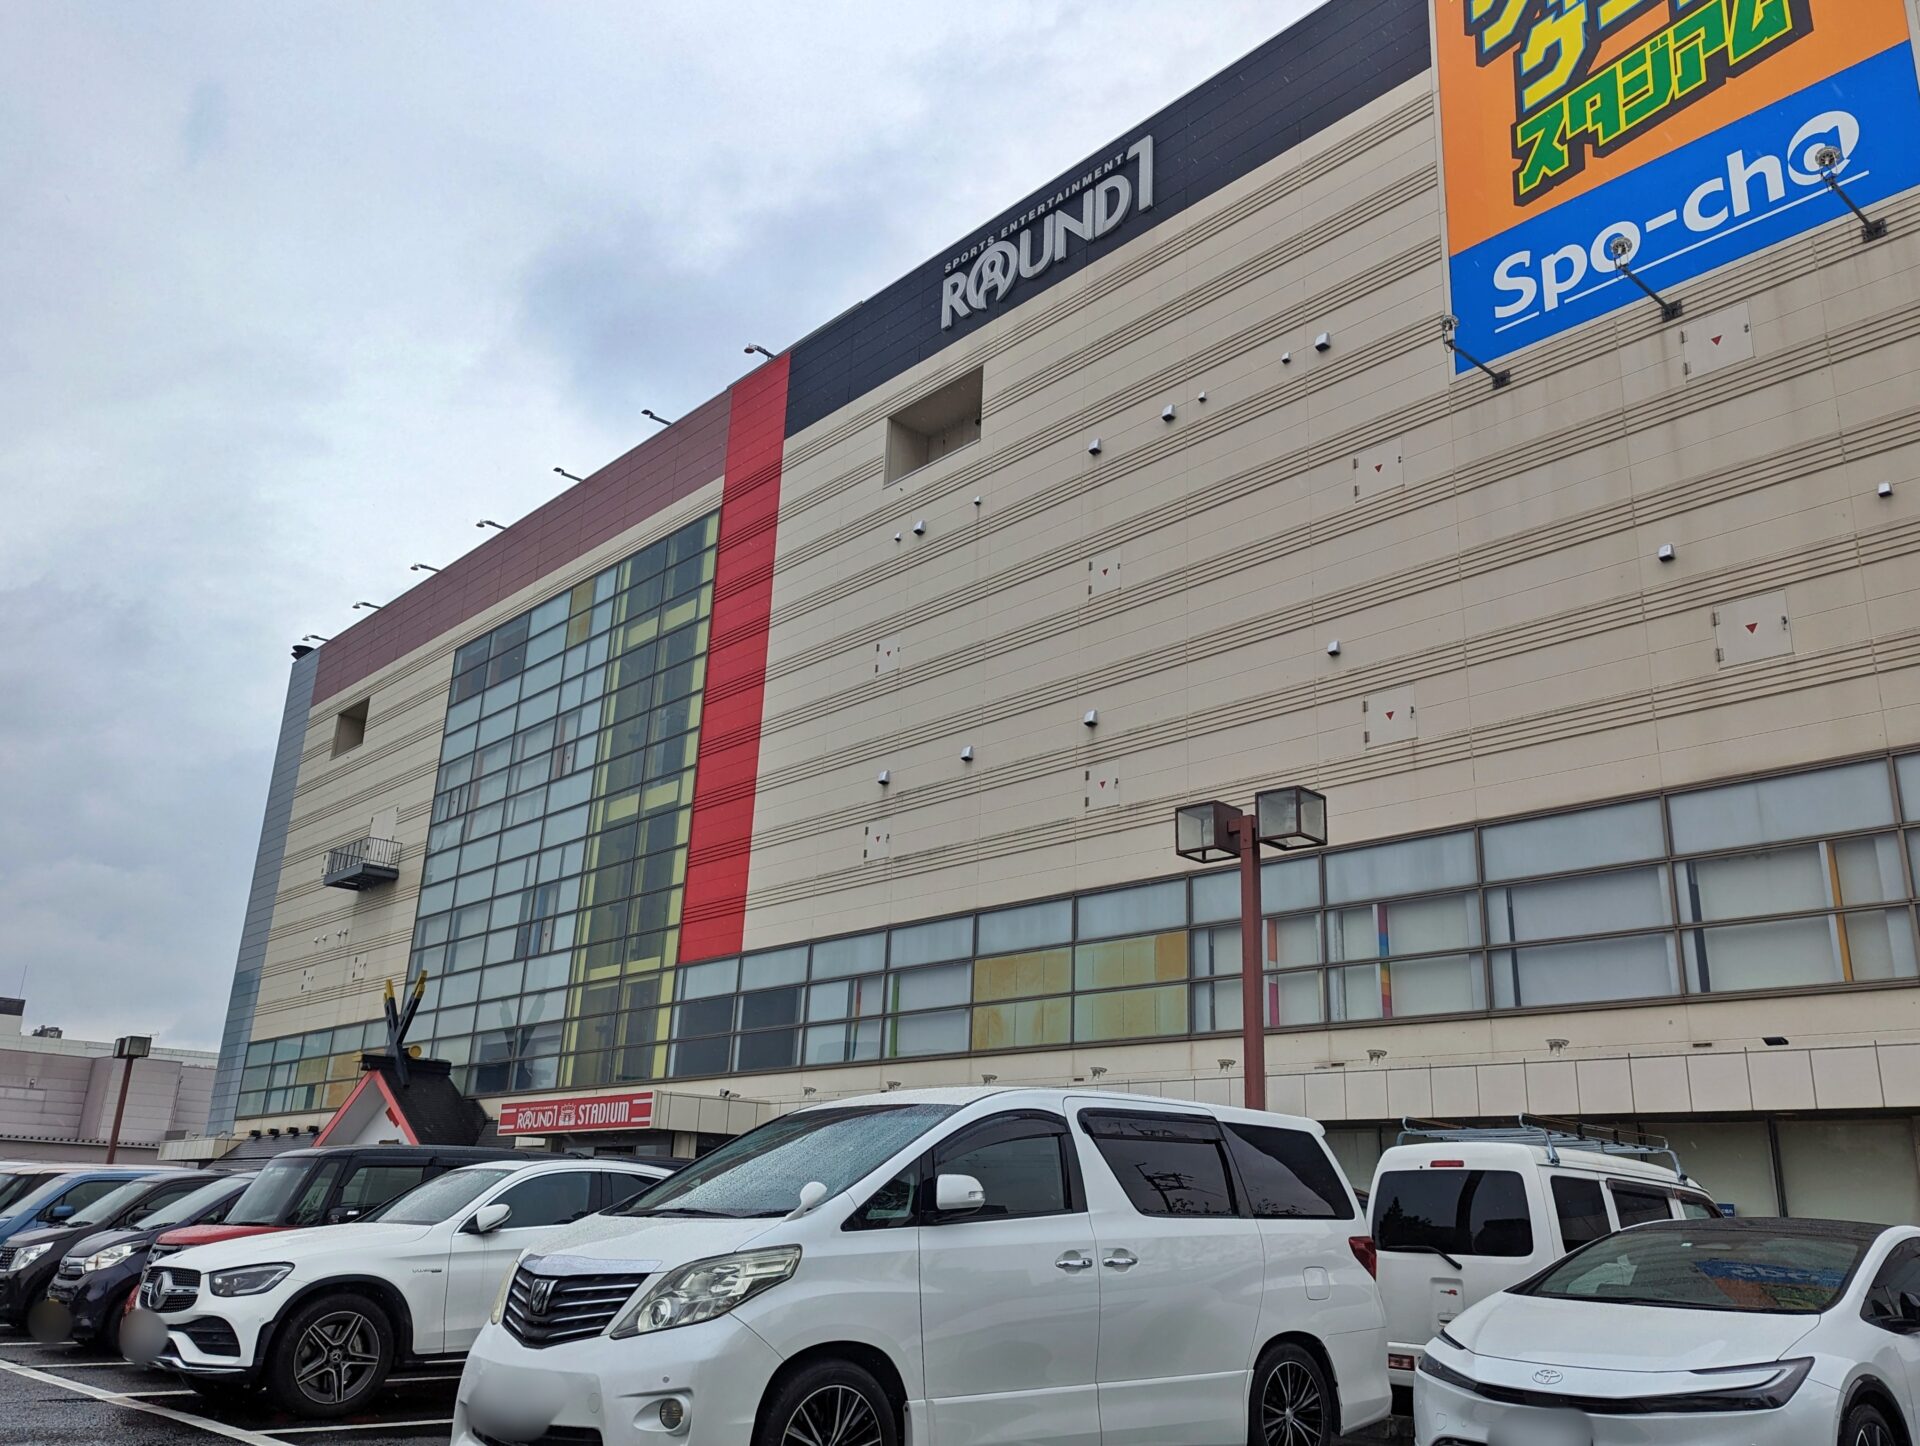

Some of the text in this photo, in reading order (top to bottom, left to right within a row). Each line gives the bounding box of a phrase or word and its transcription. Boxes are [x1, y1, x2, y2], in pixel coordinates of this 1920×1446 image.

[941, 134, 1154, 331] ROUND1
[944, 152, 1125, 274] SPORTS ENTERTAINMENT
[1493, 110, 1860, 319] Spo-cha
[516, 1101, 630, 1129] ROUND1 STADIUM
